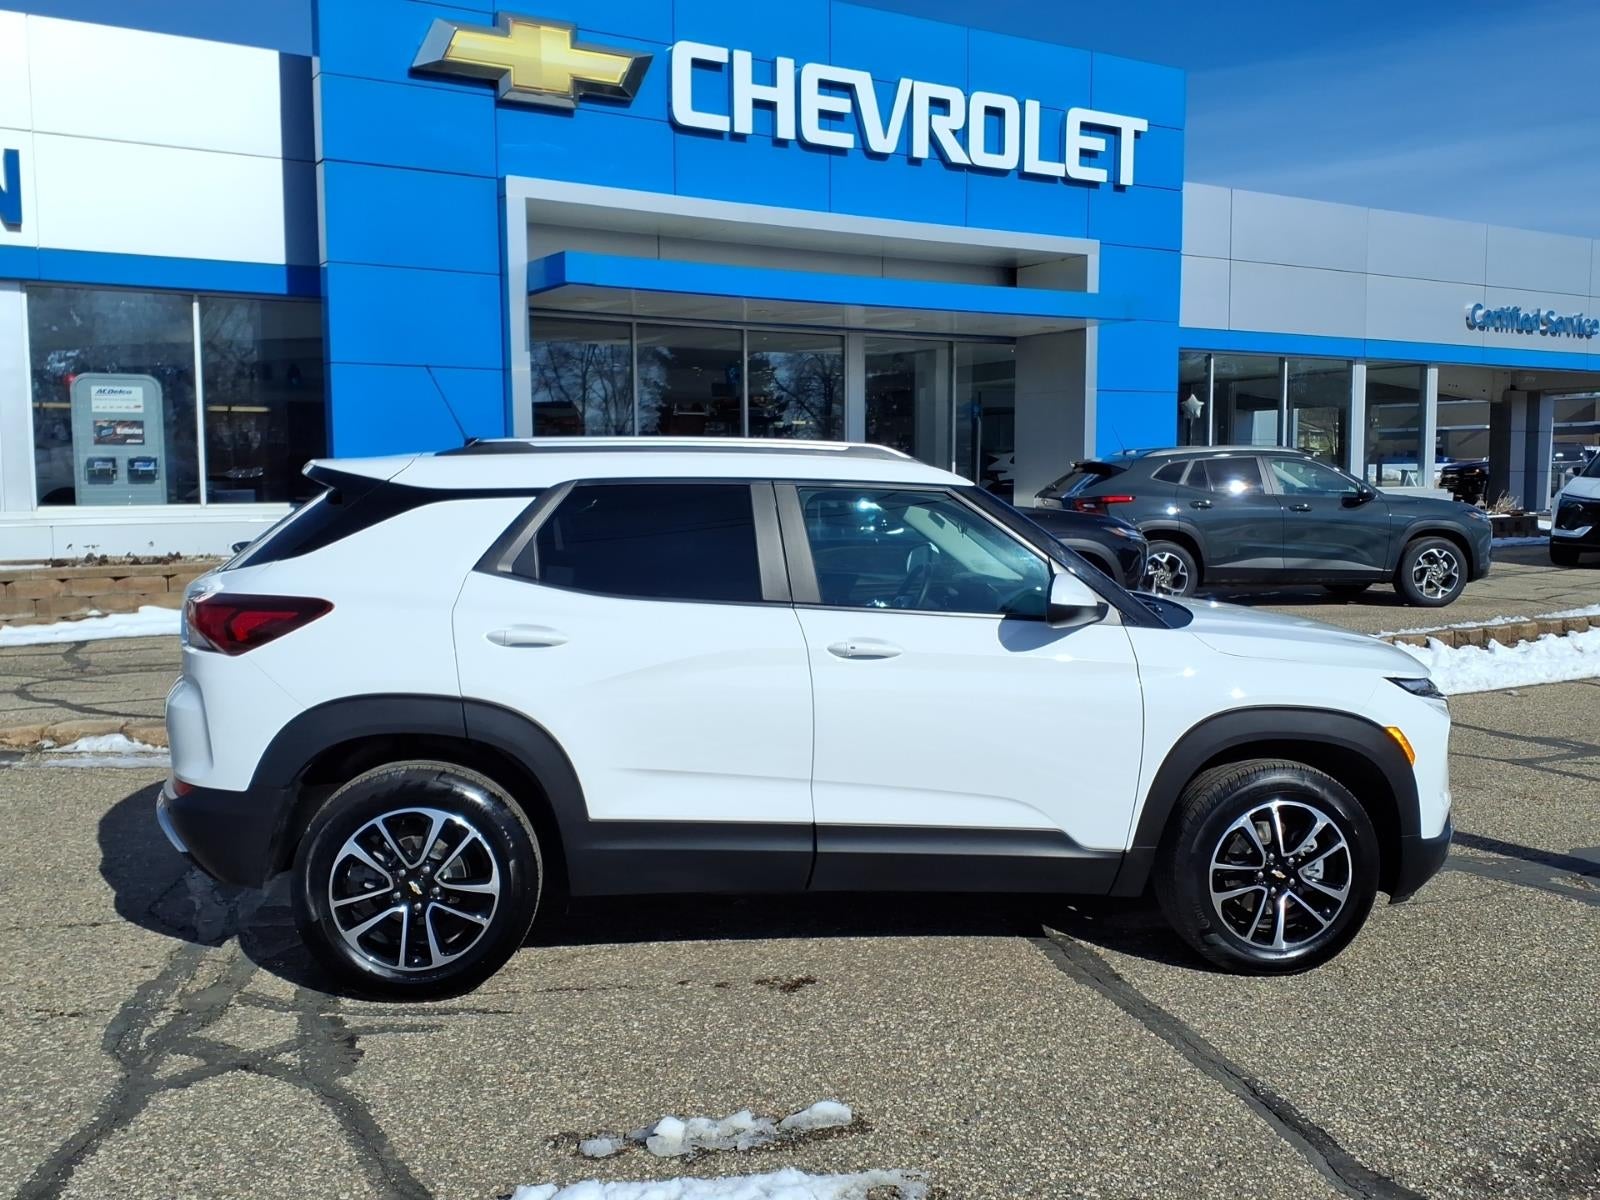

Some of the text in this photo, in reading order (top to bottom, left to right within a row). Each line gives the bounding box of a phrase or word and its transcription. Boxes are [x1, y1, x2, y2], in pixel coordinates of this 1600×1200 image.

[671, 40, 1149, 187] CHEVROLET
[1467, 303, 1600, 337] Certified Service
